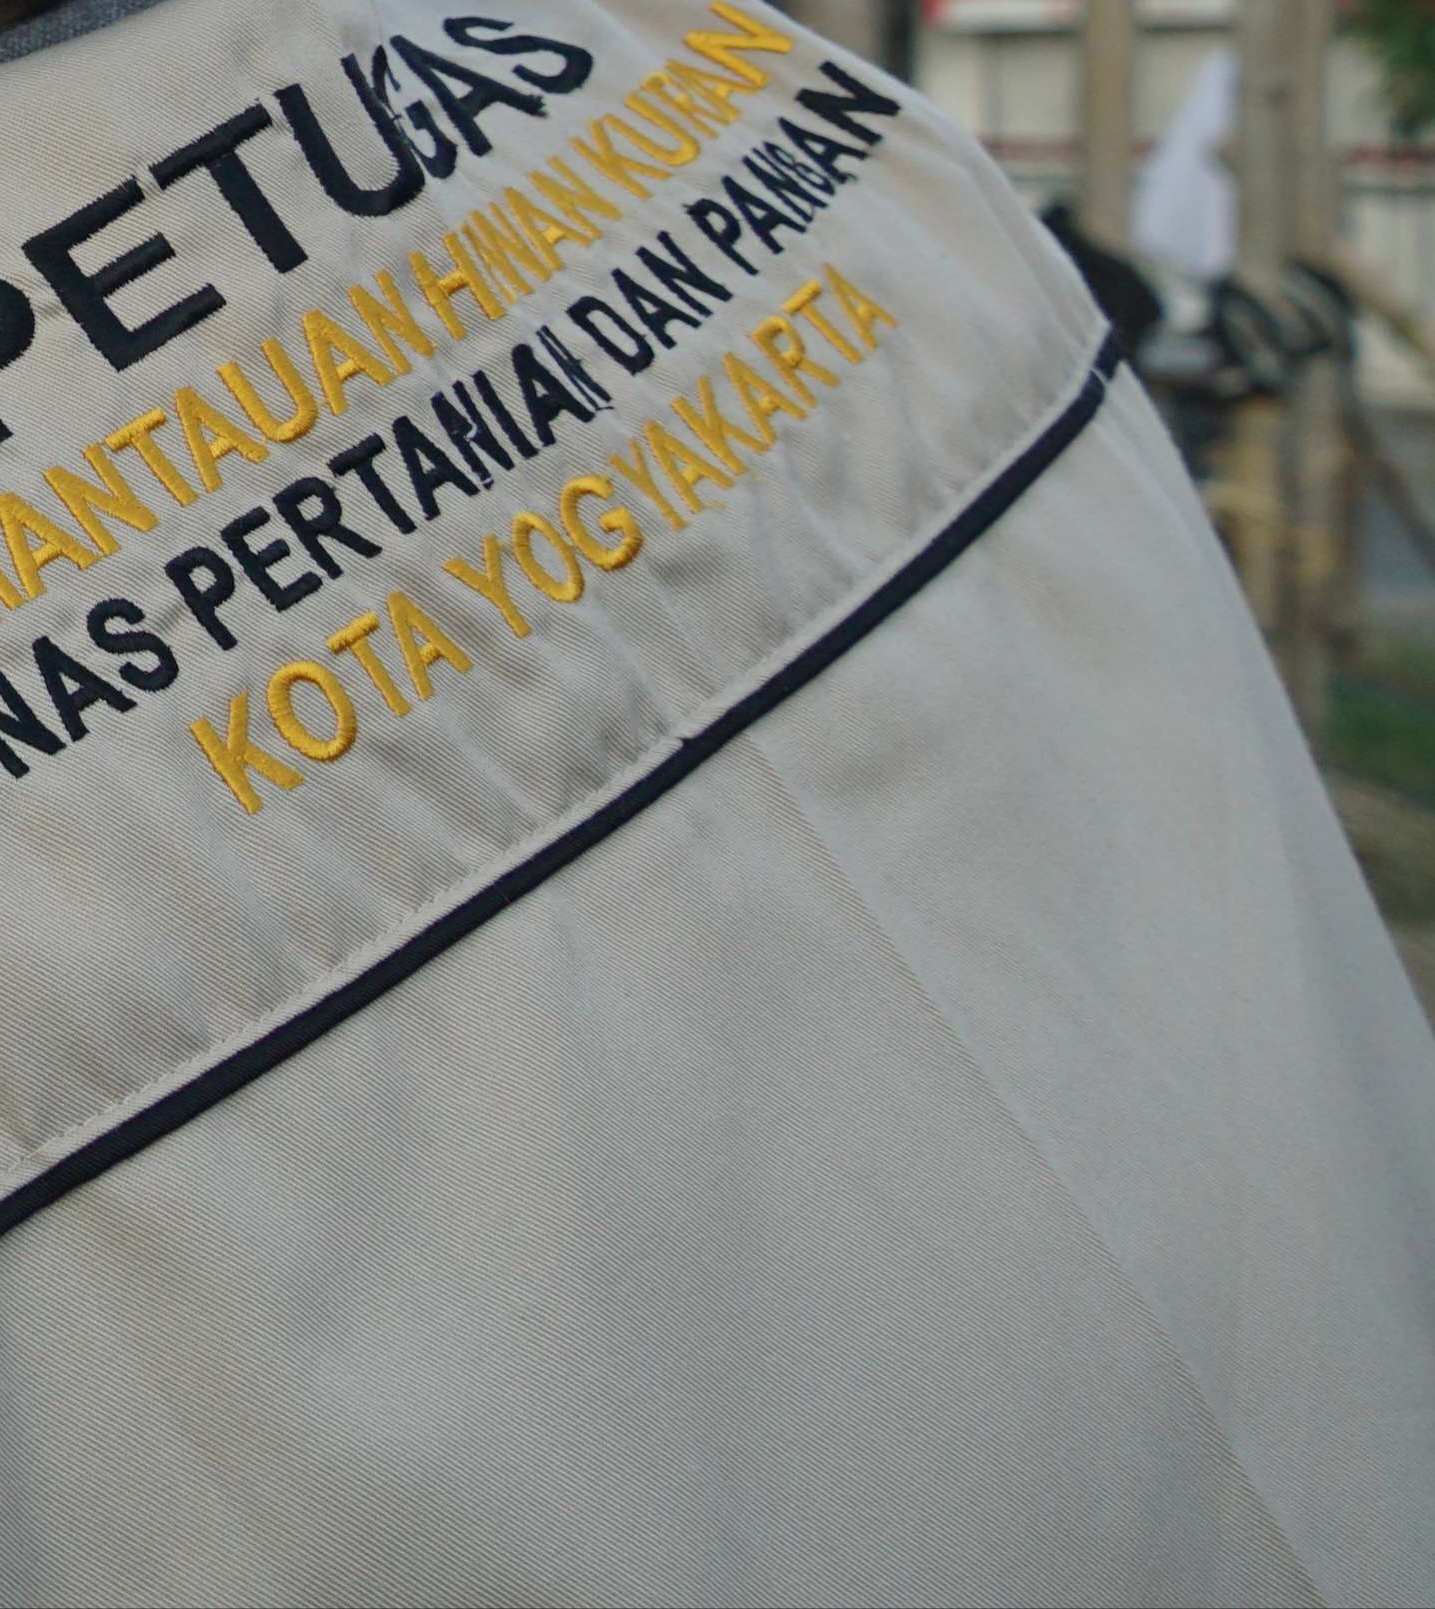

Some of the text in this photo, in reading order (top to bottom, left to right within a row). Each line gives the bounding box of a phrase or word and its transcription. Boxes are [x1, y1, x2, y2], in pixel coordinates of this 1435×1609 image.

[568, 0, 795, 200] KURAN
[163, 324, 615, 652] PERTANIAN
[564, 230, 734, 377] DAN
[189, 262, 899, 816] KOTA YOGYAKARTA
